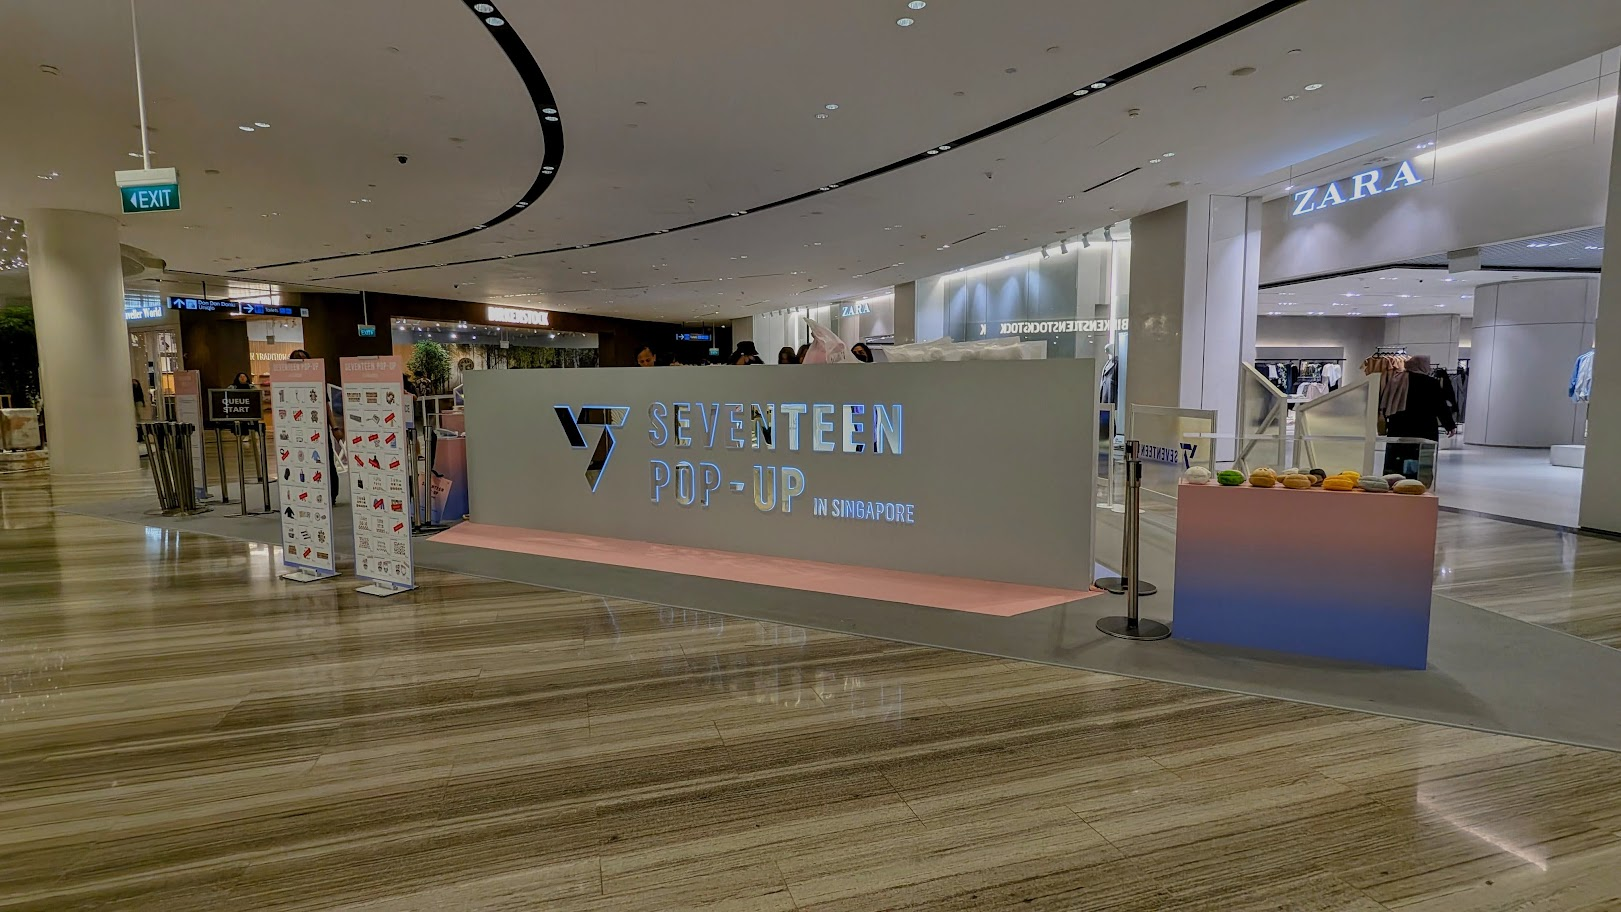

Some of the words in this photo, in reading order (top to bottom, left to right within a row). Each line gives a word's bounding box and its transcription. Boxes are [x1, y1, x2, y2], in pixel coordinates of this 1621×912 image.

[138, 189, 171, 209] EXIT
[1292, 160, 1422, 216] ZARA
[842, 302, 871, 317] ZARA
[222, 398, 250, 406] QUEUE
[647, 401, 903, 455] SEVENTEEN
[649, 459, 805, 513] POP-UP
[813, 497, 828, 516] IN
[832, 499, 915, 523] SINGAPORE
